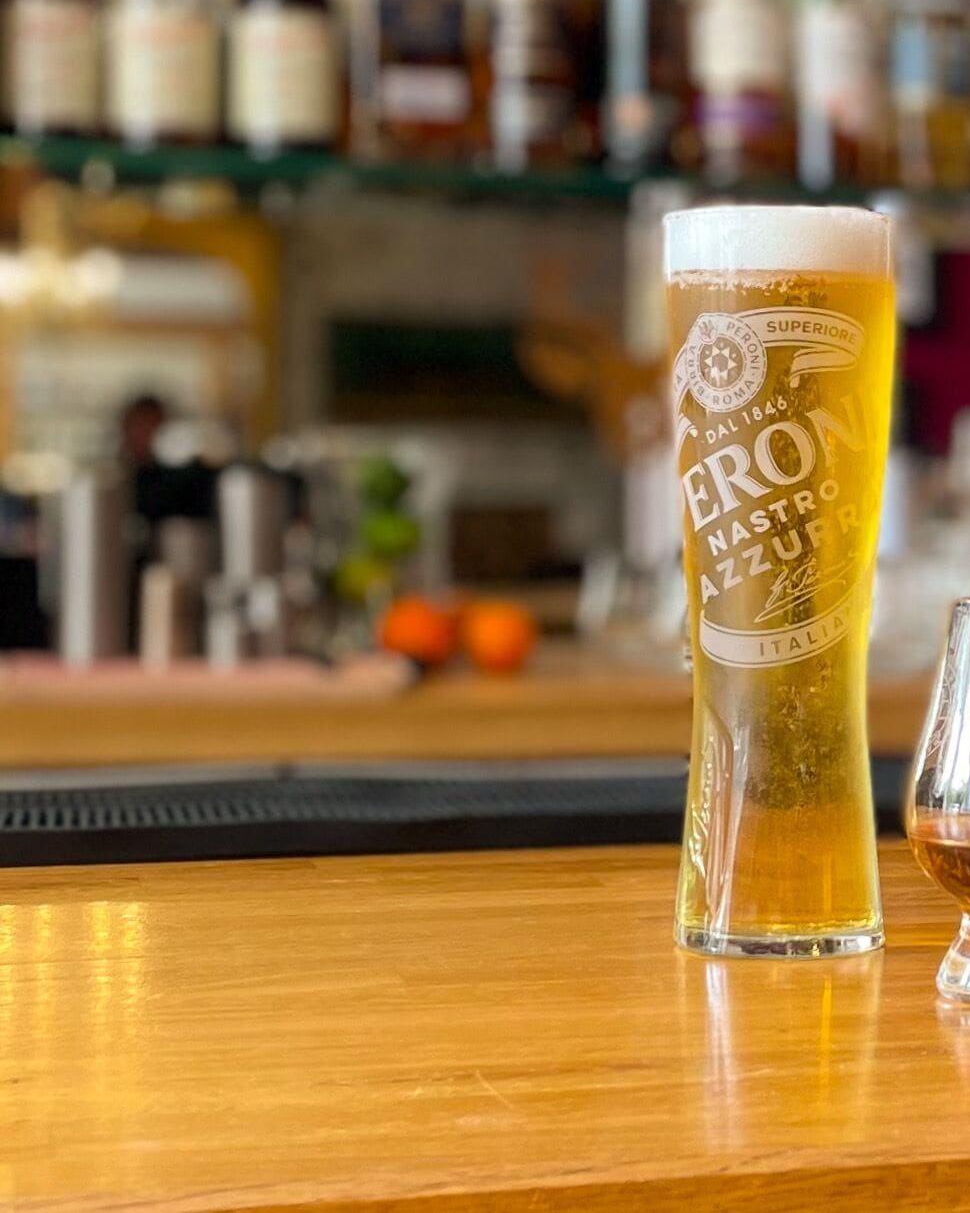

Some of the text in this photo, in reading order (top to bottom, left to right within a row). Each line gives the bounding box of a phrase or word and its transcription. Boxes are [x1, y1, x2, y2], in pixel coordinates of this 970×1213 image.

[726, 321, 762, 370] PERONI
[766, 319, 857, 345] SUPERIORE
[712, 379, 755, 406] ROMA
[705, 396, 788, 445] DAL 1846
[682, 393, 867, 533] ERON
[707, 479, 840, 557] NASTRO
[700, 502, 862, 605] AZZURR
[759, 607, 852, 657] ITALIA
